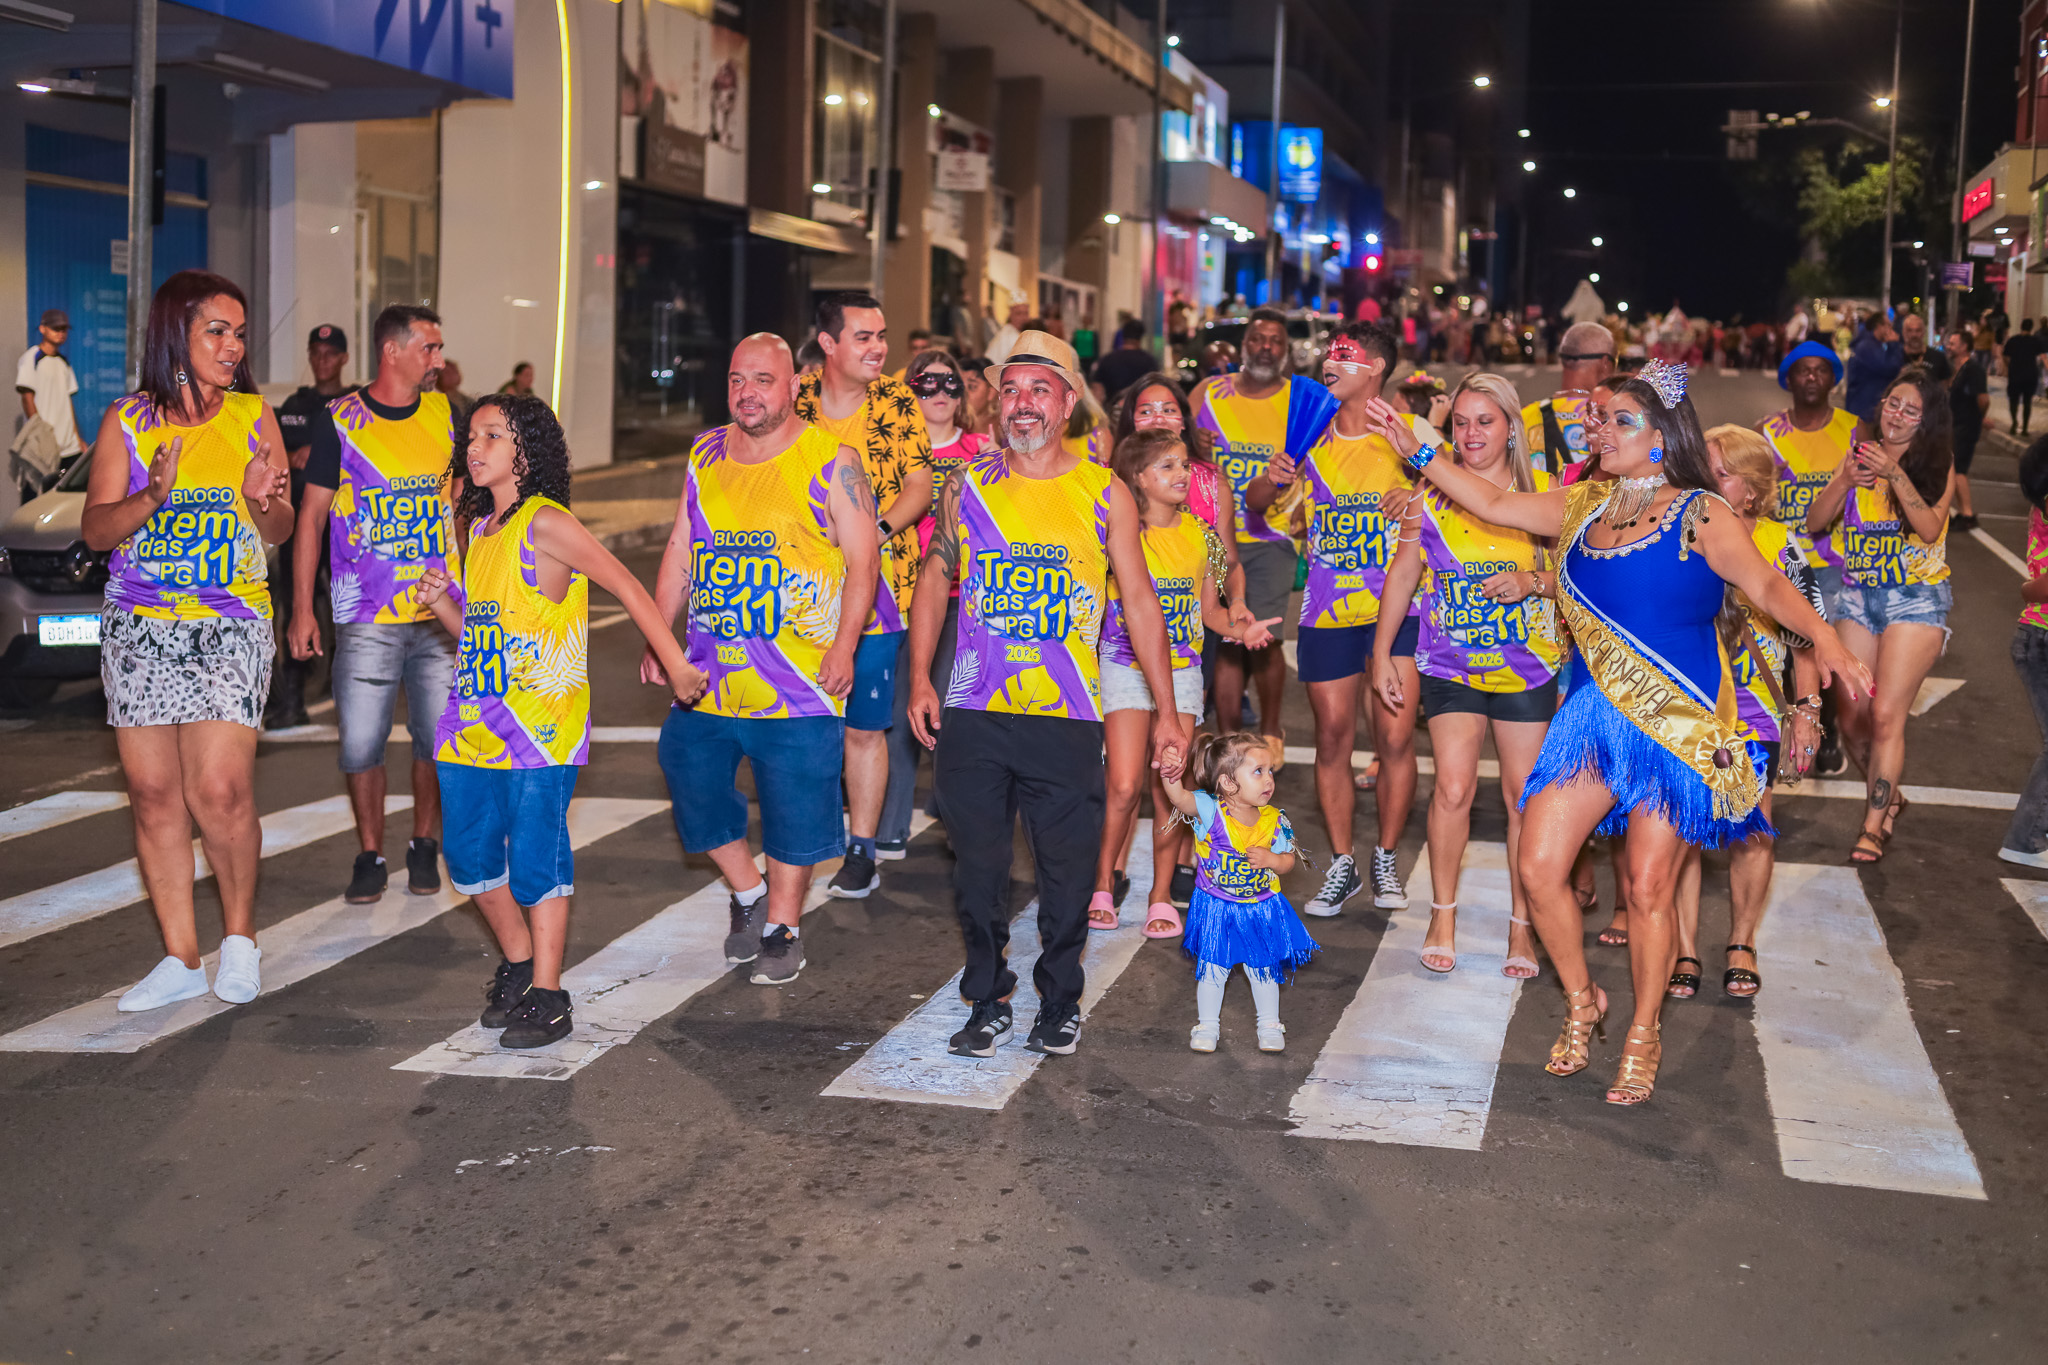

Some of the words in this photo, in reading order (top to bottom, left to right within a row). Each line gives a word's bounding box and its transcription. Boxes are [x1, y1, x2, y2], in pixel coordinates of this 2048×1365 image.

[1230, 442, 1274, 456] BLOCO
[934, 457, 966, 467] LOCO
[390, 475, 438, 491] BLOCO
[1796, 472, 1833, 483] BLOCO
[170, 488, 234, 504] BLOCO
[360, 488, 444, 521] Trem
[1336, 492, 1381, 507] BLOCO
[1315, 503, 1385, 535] Trem
[1775, 505, 1806, 520] das
[1863, 520, 1901, 532] BLOCO
[371, 522, 409, 542] das
[412, 518, 445, 554] 11
[713, 531, 775, 548] BLOCO
[1846, 526, 1903, 557] Trem
[393, 542, 419, 559] PG
[1011, 543, 1068, 561] BLOCO
[1320, 535, 1349, 551] das
[1351, 532, 1384, 565] 11
[139, 537, 184, 558] das
[188, 539, 230, 584] 11
[692, 542, 780, 588] Trem
[1334, 553, 1358, 569] PG
[1464, 562, 1517, 576] BLOCO
[1847, 555, 1872, 570] das
[1874, 555, 1903, 584] 11
[160, 562, 193, 586] PG
[977, 551, 1072, 597] Trem
[1334, 575, 1365, 588] 2026
[1858, 573, 1878, 587] PG
[1156, 578, 1194, 589] BLOCO
[1438, 571, 1499, 608] Tre
[692, 587, 725, 610] das
[730, 586, 775, 635] 11
[982, 592, 1025, 615] das
[1028, 594, 1068, 638] 11
[709, 611, 737, 638] PG
[1004, 615, 1035, 638] PG
[1168, 613, 1193, 642] 11
[1445, 607, 1483, 627] das
[1487, 605, 1527, 641] 11
[1465, 628, 1495, 646] PG
[715, 645, 748, 665] 2026
[1005, 645, 1042, 663] 2026
[1466, 652, 1505, 667] 2026
[472, 653, 503, 694] 11
[1567, 609, 1587, 633] DO
[1585, 627, 1679, 721] CARNAVAL
[459, 703, 481, 721] 026
[1217, 850, 1263, 876] Tre
[1219, 874, 1247, 885] das
[1235, 887, 1254, 897] PG
